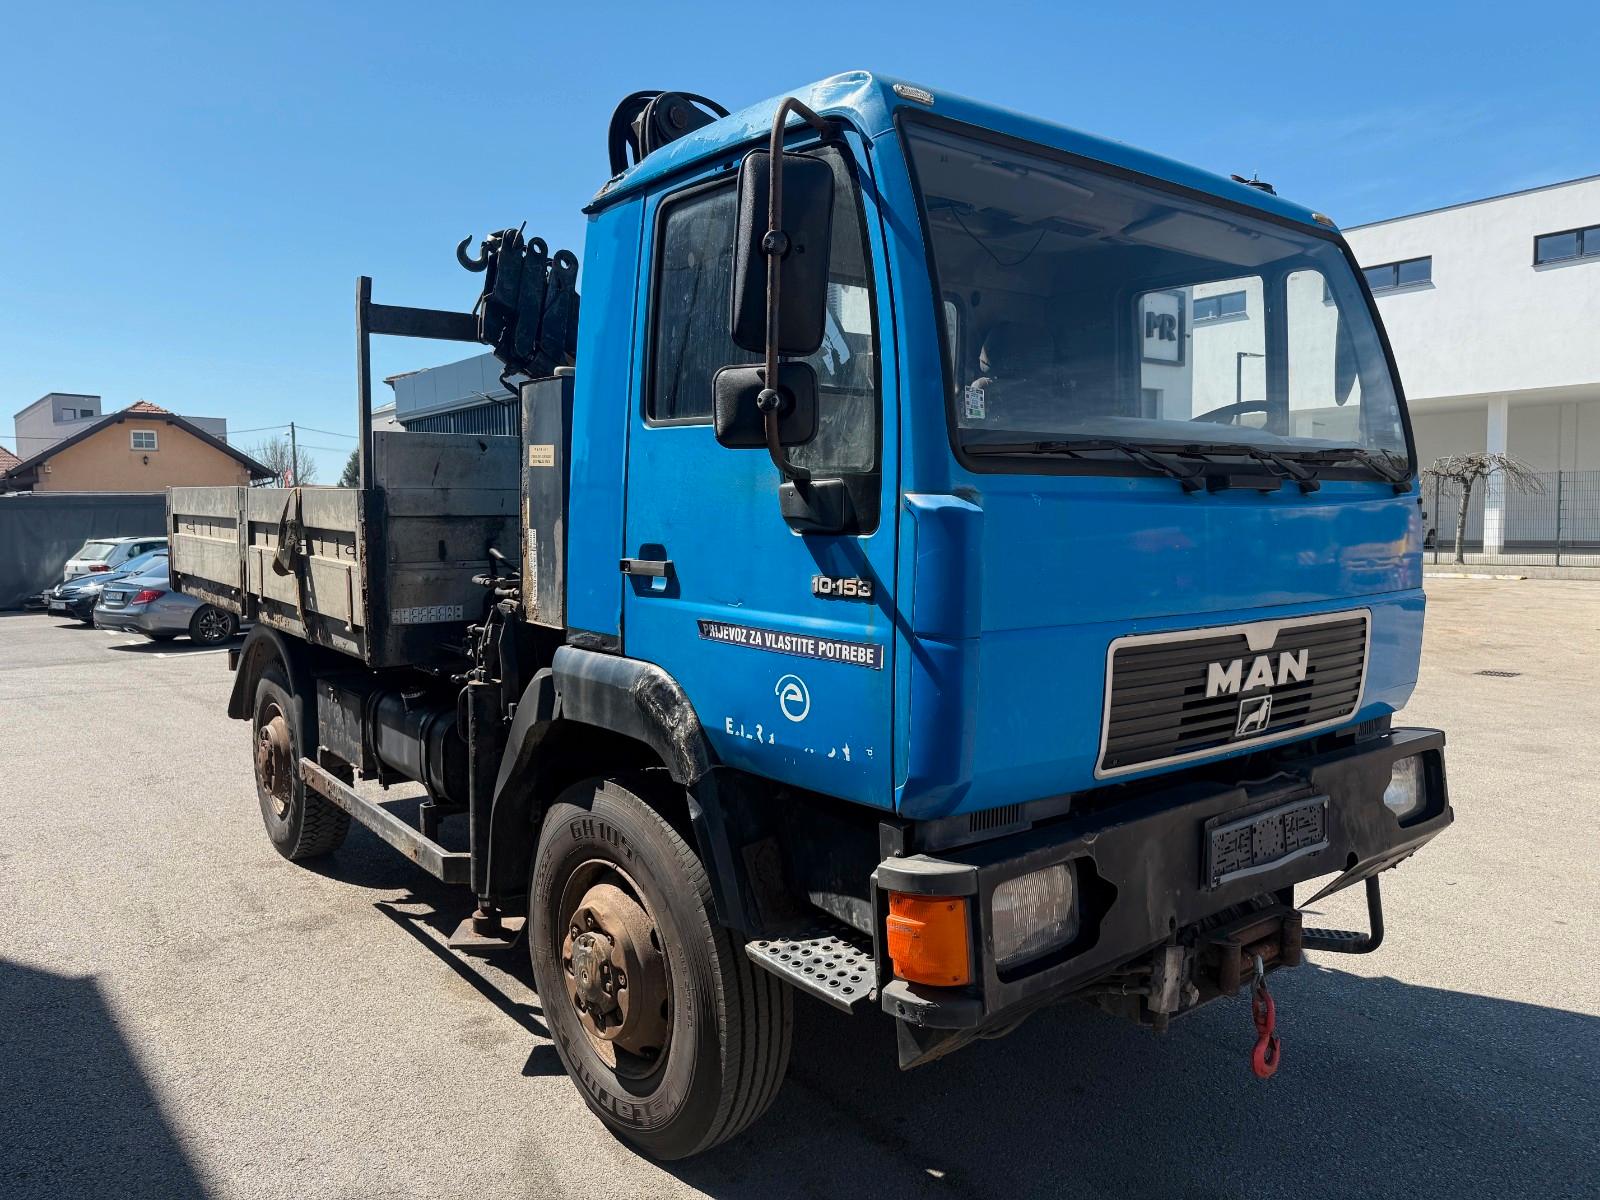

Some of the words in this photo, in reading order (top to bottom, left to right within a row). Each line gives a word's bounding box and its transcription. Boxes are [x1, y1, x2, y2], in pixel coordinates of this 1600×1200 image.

[702, 623, 747, 643] PRIJEVOZ
[749, 630, 762, 646] ZA
[764, 633, 815, 655] VLASTITE
[818, 641, 874, 664] POTREBE
[1206, 649, 1309, 698] MAN
